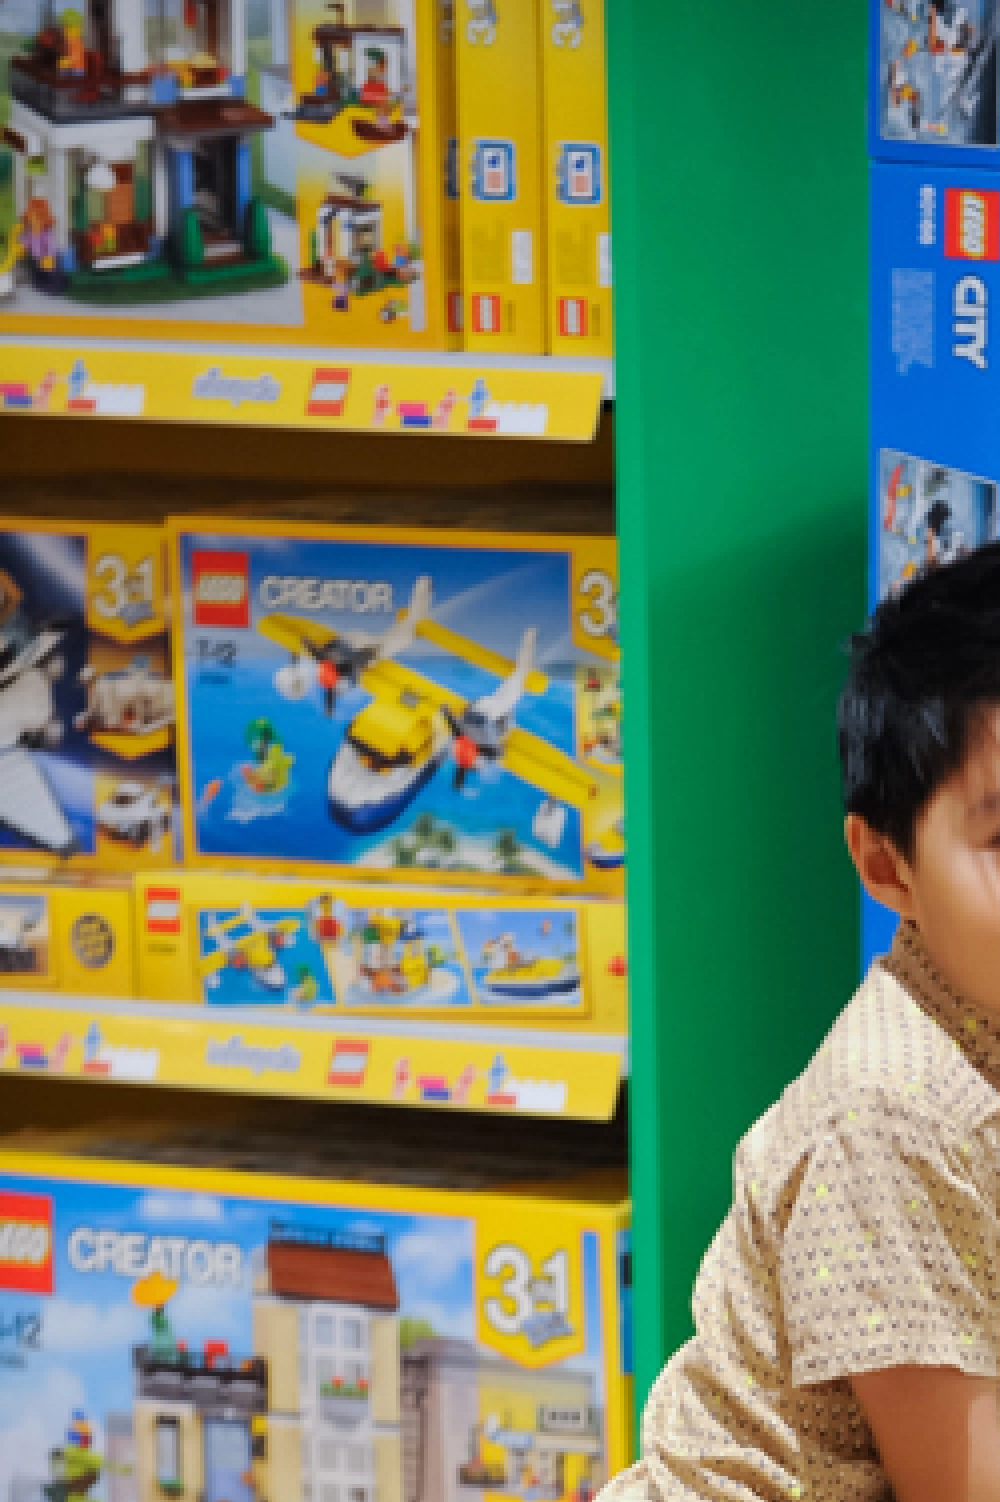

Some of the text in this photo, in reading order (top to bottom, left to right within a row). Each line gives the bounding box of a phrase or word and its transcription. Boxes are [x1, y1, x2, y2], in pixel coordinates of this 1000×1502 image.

[952, 191, 988, 370] LEGO CITY
[259, 575, 394, 613] CREATOR
[0, 1220, 243, 1290] EGO CREATOR
